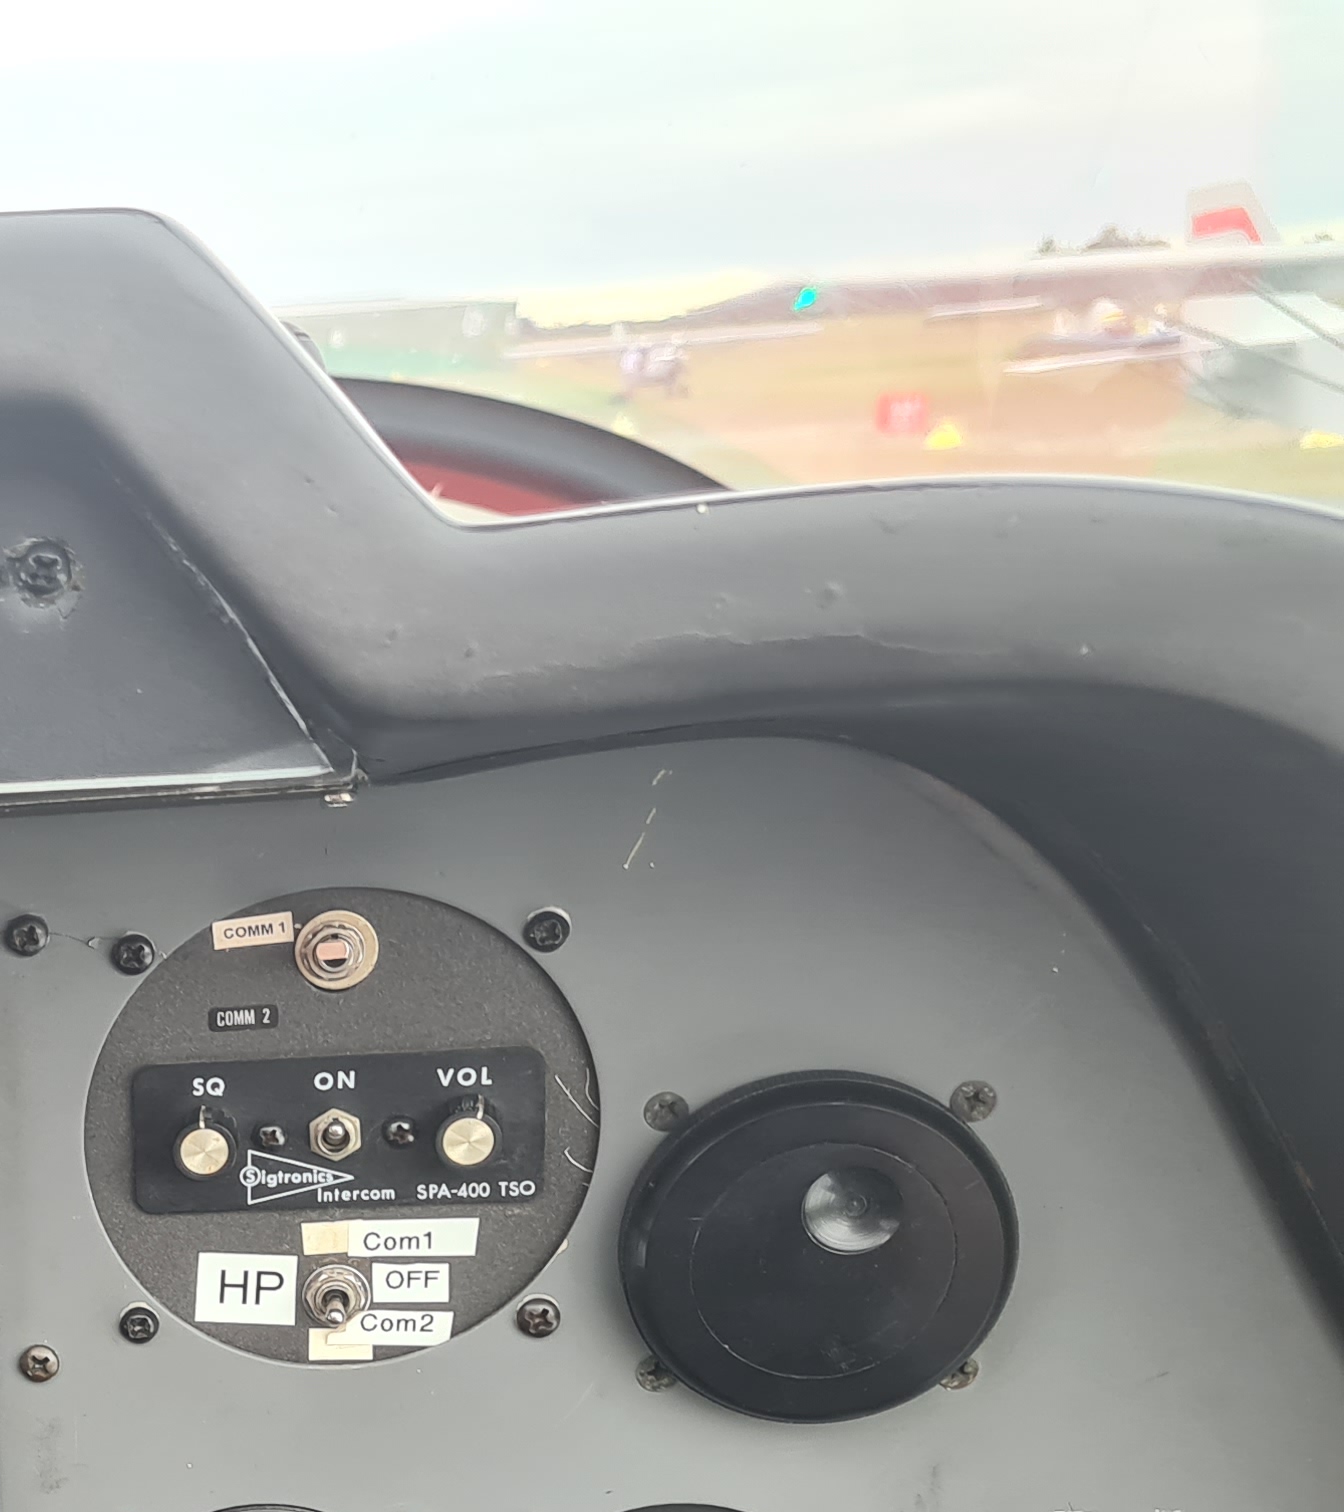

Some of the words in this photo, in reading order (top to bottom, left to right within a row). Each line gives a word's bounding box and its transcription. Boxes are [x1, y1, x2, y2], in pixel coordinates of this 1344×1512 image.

[222, 923, 270, 940] COMM
[278, 921, 287, 936] 1
[216, 1010, 257, 1028] COMM
[261, 1008, 272, 1025] 2
[191, 1077, 226, 1097] SQ
[313, 1071, 356, 1091] ON
[436, 1068, 493, 1087] VOL
[239, 1166, 335, 1190] Sigtronics
[317, 1186, 396, 1204] Intercom
[363, 1232, 435, 1252] Com1
[219, 1269, 285, 1306] HP
[385, 1270, 440, 1290] OFF
[359, 1313, 435, 1333] Com2
